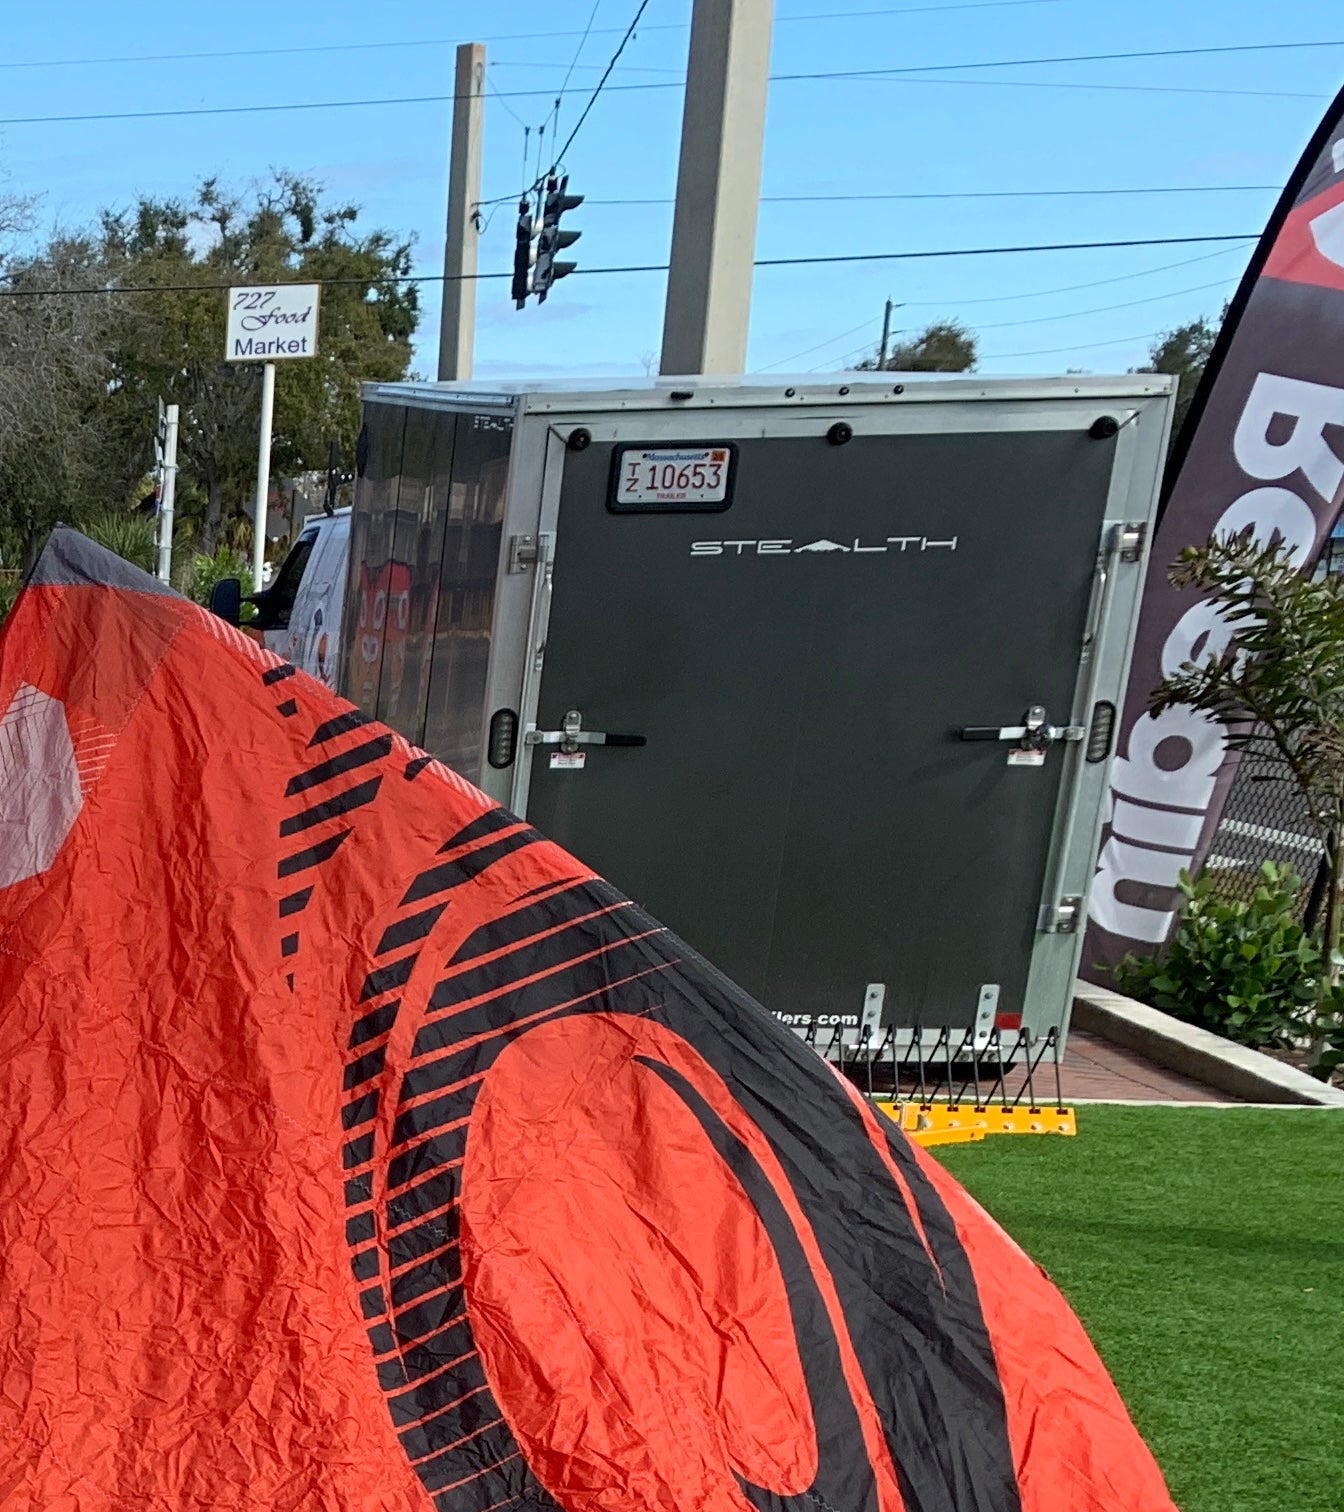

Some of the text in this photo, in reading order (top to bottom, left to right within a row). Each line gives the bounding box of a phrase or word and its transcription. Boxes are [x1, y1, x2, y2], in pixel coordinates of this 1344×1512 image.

[233, 291, 277, 311] 727
[234, 336, 308, 356] Market
[646, 464, 723, 490] 10653
